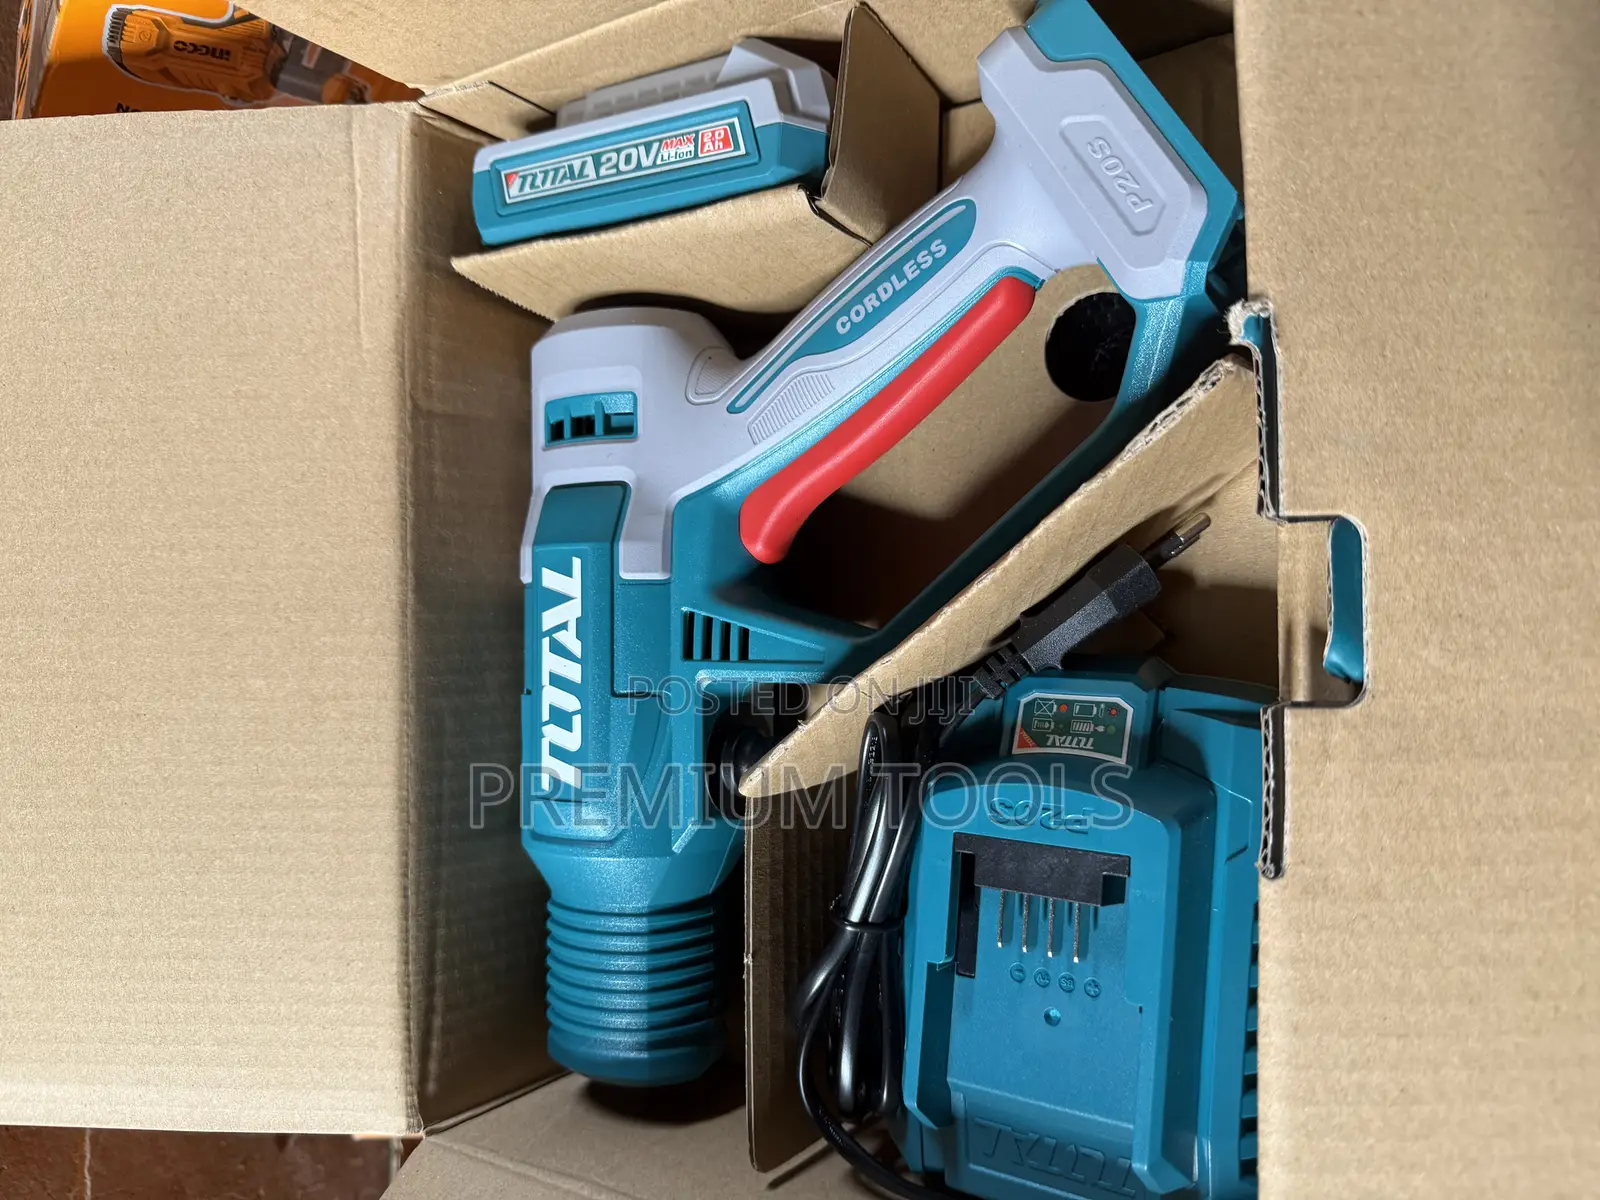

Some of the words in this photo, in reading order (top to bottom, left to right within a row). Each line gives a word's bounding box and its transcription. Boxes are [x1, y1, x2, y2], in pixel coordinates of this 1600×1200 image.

[661, 133, 695, 151] MAX
[703, 129, 725, 143] 2.0
[703, 140, 724, 153] Ah
[517, 159, 590, 193] TOTAL
[599, 142, 660, 177] 20V
[1087, 136, 1154, 214] P20S
[836, 238, 948, 335] CORDLESS
[542, 556, 582, 792] TOTAL
[1046, 734, 1094, 749] TOTAL
